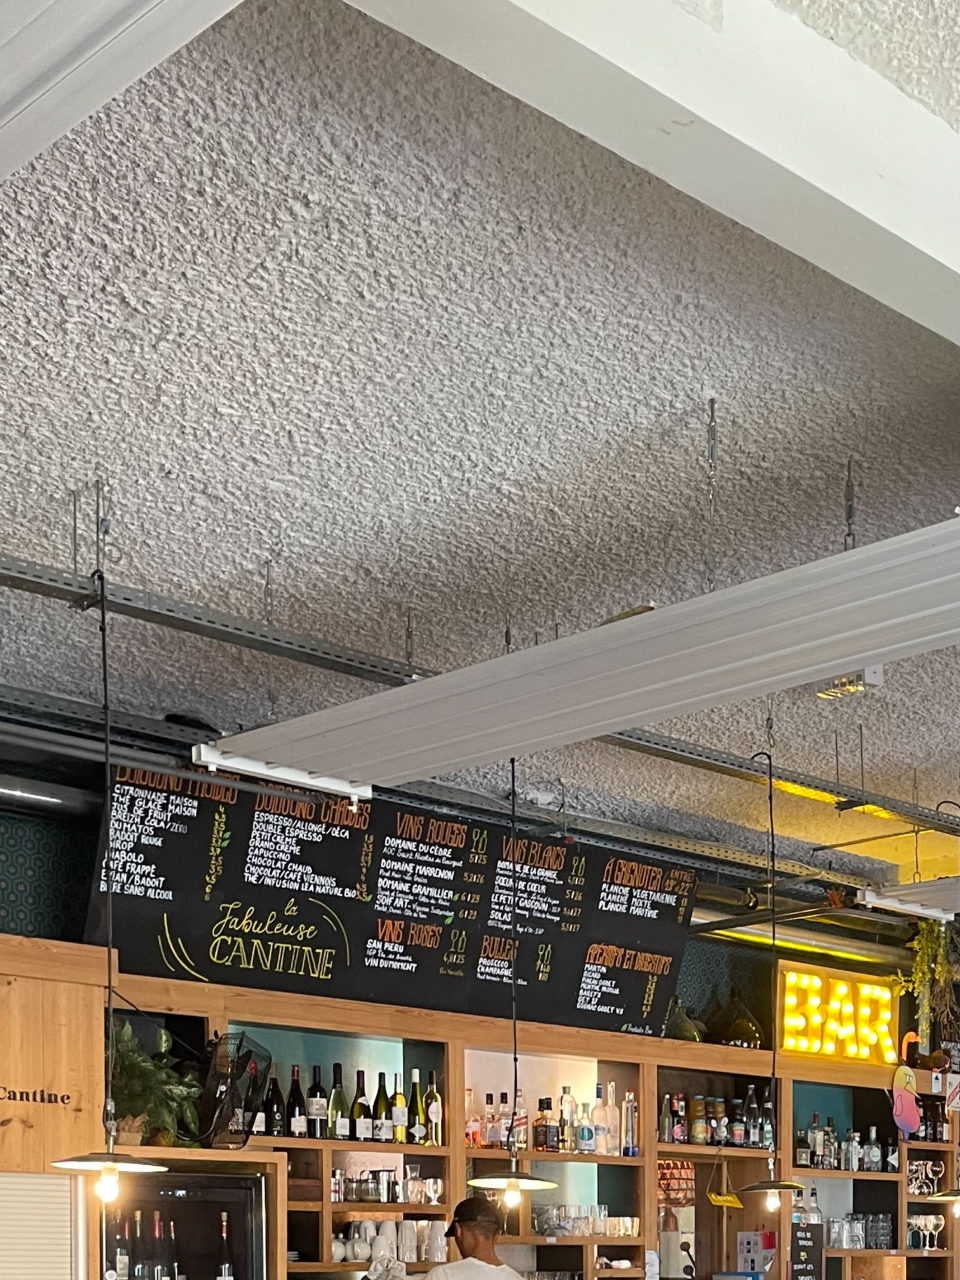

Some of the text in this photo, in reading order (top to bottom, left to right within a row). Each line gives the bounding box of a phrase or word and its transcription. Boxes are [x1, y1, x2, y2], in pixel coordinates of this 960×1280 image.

[114, 784, 198, 807] CITRONNADE MAISON
[111, 810, 140, 824] BREIZH
[112, 803, 171, 821] JUS DE FRUIT
[168, 805, 197, 817] MAISON
[110, 829, 138, 842] BADOIT
[123, 823, 154, 835] MATOS
[253, 822, 322, 842] DOUBLE ESPRESSO
[396, 812, 467, 848] VINS ROUGES
[251, 831, 271, 842] PETIT
[249, 840, 275, 850] GRAND
[385, 837, 417, 851] DOMAINE
[419, 843, 429, 853] DU
[248, 847, 291, 861] CAPUCCINO
[528, 841, 567, 871] BLANCS
[247, 855, 312, 874] CHOCOLAT CHAUD
[381, 859, 415, 873] DOMAINE
[303, 874, 336, 887] VIENNOIS
[378, 878, 411, 893] DOMAINE
[124, 883, 145, 896] SANS
[315, 885, 343, 897] NATURE
[490, 910, 511, 922] SOLAS
[378, 919, 404, 943] VINS
[210, 935, 335, 979] CANTINE
[364, 957, 379, 968] VIN
[784, 971, 898, 1064] BAR
